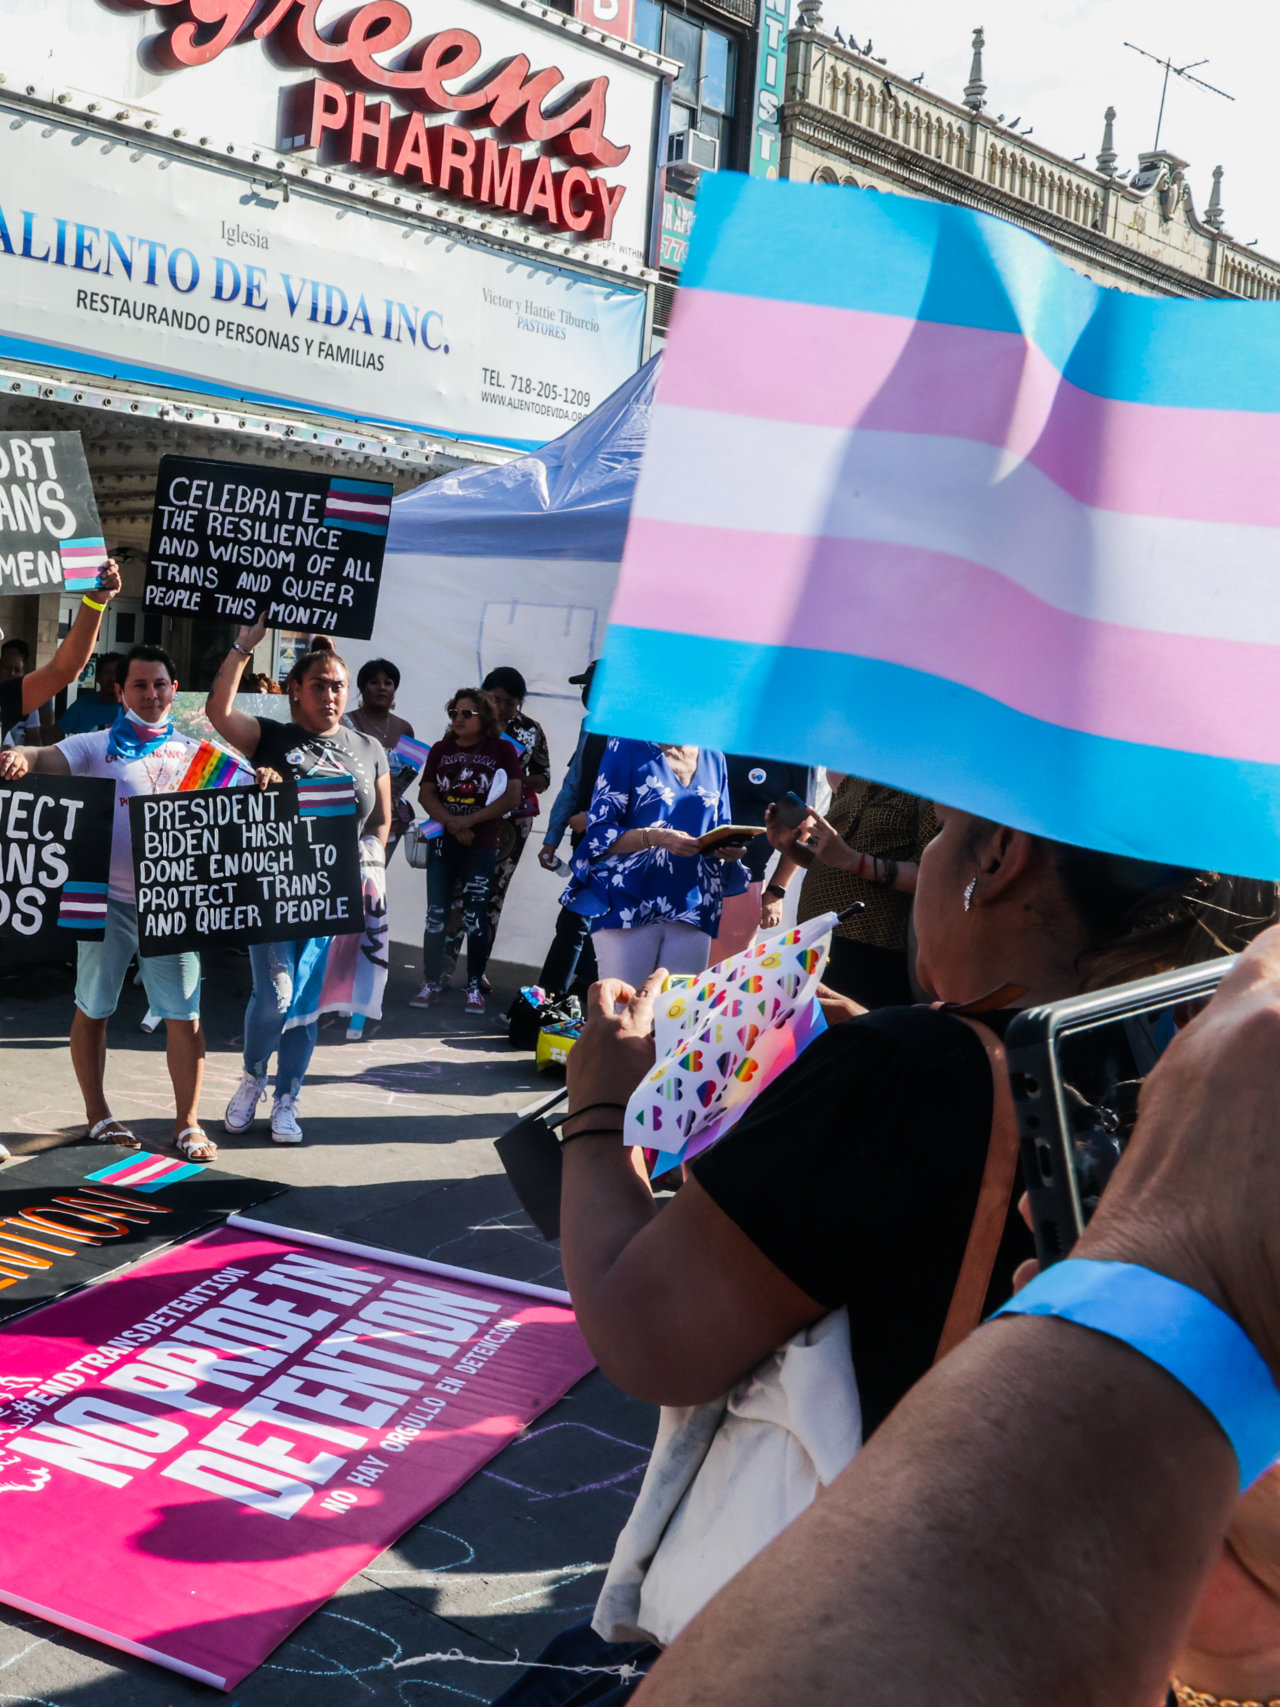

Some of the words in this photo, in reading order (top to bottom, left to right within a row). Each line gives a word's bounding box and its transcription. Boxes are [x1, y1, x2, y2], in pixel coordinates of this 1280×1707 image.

[145, 0, 630, 168] greens
[312, 77, 627, 241] PHARMACY
[220, 219, 270, 251] Iglesia
[211, 256, 268, 311] DE
[278, 272, 375, 336] VIDA
[381, 299, 451, 355] INC.
[482, 287, 514, 310] Victor
[515, 301, 523, 314] y
[524, 298, 556, 321] Hattie
[558, 308, 600, 333] Tiburcio
[517, 315, 567, 341] PASTORES
[76, 288, 211, 335] RESTAURANDO
[215, 318, 300, 354] PERSONAS
[304, 337, 315, 356] Y
[317, 340, 385, 373] FAMILIAS
[482, 367, 505, 389] TEL.
[510, 374, 591, 407] 718-205-1209
[169, 476, 322, 524] CELEBRATE
[158, 505, 198, 532] THE
[207, 512, 343, 550] RESILIENCE
[158, 535, 199, 558] AND
[209, 540, 295, 572] WISDOM
[306, 554, 336, 576] OF
[343, 557, 375, 583] ALL
[151, 560, 219, 589] TRANS
[236, 571, 271, 593] AND
[282, 576, 355, 607] QUEER
[145, 585, 202, 611] PEOPLE
[214, 593, 257, 619] THIS
[268, 601, 338, 630] MONTH
[143, 791, 280, 832] PRESIDENT
[144, 827, 220, 859] BIDEN
[241, 815, 317, 849] HASN'T
[139, 858, 198, 884] DONE
[209, 850, 294, 876] ENOUGH
[309, 843, 337, 868] TO
[138, 882, 238, 913] PROTECT
[256, 871, 332, 900] TRANS
[144, 911, 187, 937] AND
[195, 904, 262, 935] QUEER
[275, 896, 349, 924] PEOPLE
[11, 1266, 251, 1416] #ENDTRANSDETENTION
[5, 1397, 190, 1488] NO
[101, 1288, 340, 1418] PRIDE
[253, 1253, 386, 1307] IN
[160, 1279, 502, 1521] DETENTION
[320, 1489, 359, 1515] NO
[346, 1454, 389, 1487] HAY
[379, 1397, 447, 1453] ORGULLO
[435, 1376, 467, 1395] EN
[454, 1318, 522, 1375] DETENCION
